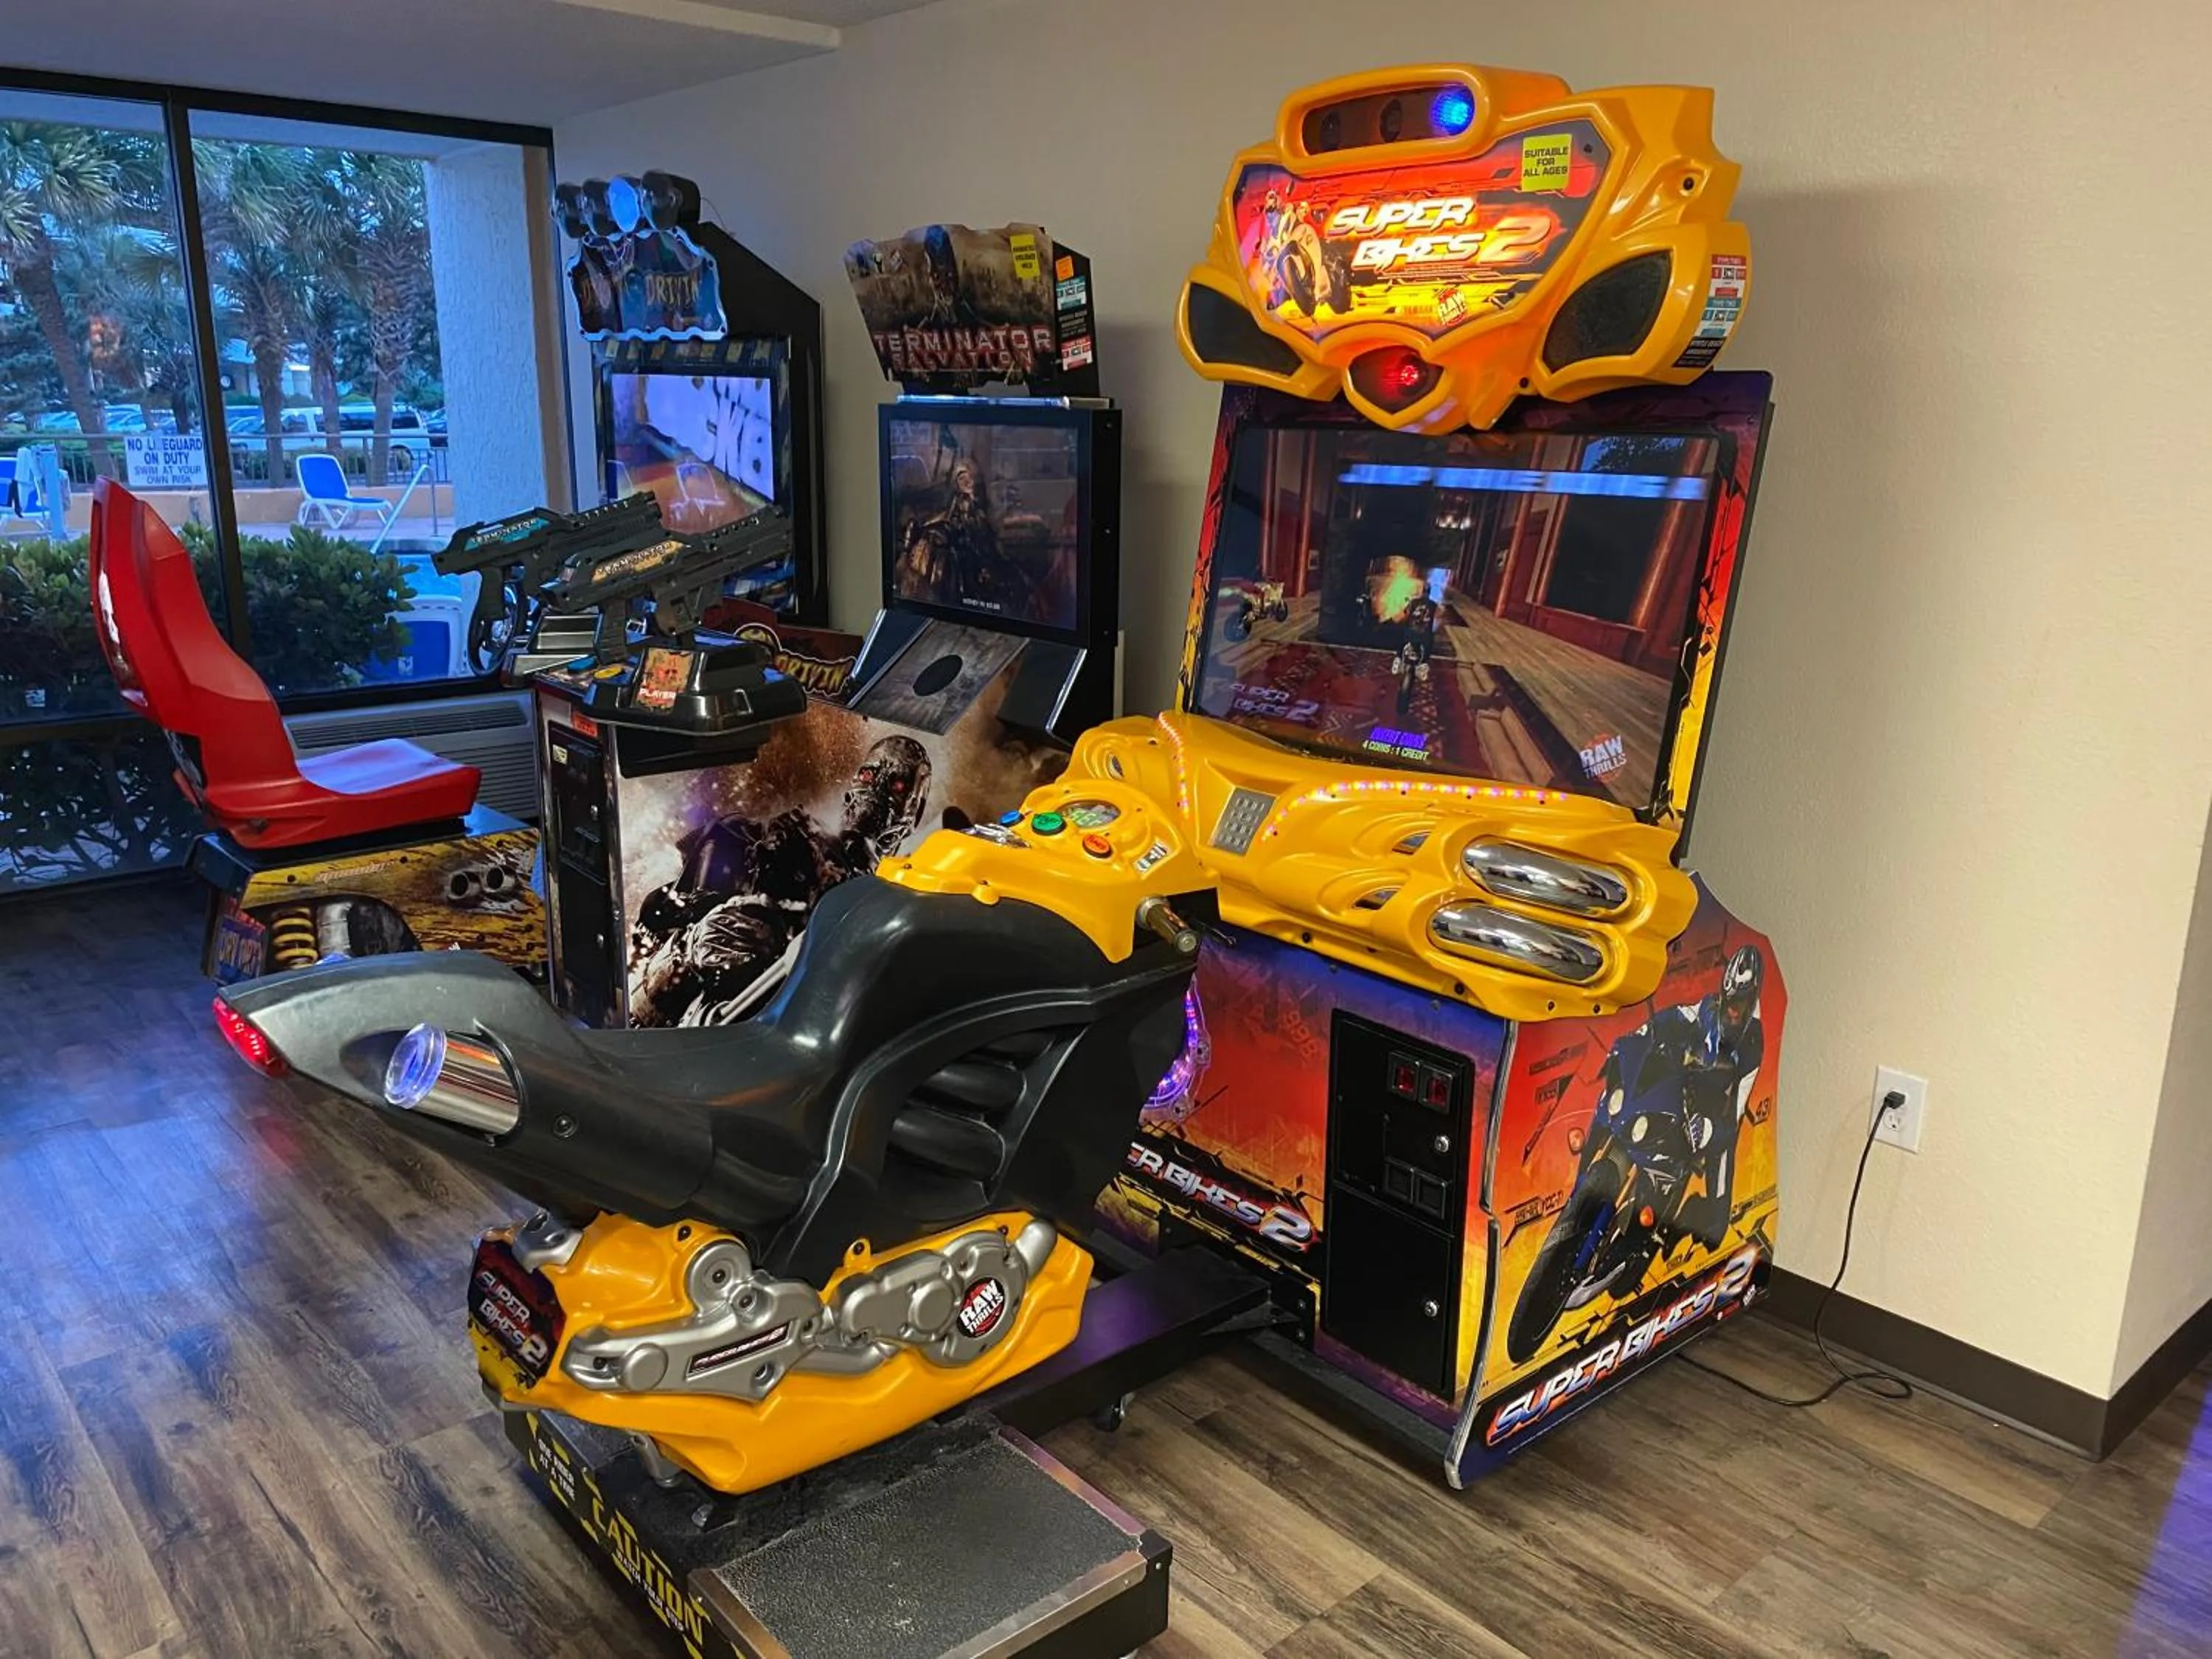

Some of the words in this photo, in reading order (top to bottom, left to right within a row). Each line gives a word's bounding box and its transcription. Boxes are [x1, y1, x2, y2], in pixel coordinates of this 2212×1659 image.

[1525, 147, 1569, 159] SUITABLE
[1537, 157, 1555, 167] FOR
[1523, 169, 1540, 177] ALL
[1543, 166, 1568, 175] AGES
[1327, 196, 1475, 237] SUPER
[1351, 232, 1487, 272] BIKES
[1476, 215, 1551, 264] 2
[1438, 291, 1465, 318] RAW
[874, 329, 1051, 352] TERMINATOR
[892, 350, 1032, 373] SALVATION
[128, 438, 143, 451] NO
[147, 438, 203, 451] LIEGUARD
[135, 466, 159, 475] SWIM
[163, 466, 173, 474] AT
[178, 466, 201, 474] YOUR
[145, 452, 159, 465] ON
[164, 452, 189, 465] DUTY
[147, 476, 169, 484] OWN
[639, 688, 677, 700] PLAYER
[1285, 700, 1320, 721] 2
[1580, 735, 1623, 768] RAW
[1583, 753, 1628, 779] THRILLS
[1164, 1161, 1266, 1225] BIKES
[1259, 1205, 1312, 1252] 2
[480, 1270, 530, 1324] SUPER
[959, 1279, 999, 1327] RAW
[967, 1293, 1004, 1333] THRILLS
[480, 1298, 526, 1346] BIKES
[518, 1334, 549, 1368] 2
[1492, 1339, 1622, 1440] SUPER
[1621, 1282, 1718, 1358] BIKES
[1717, 1246, 1757, 1299] 2
[592, 1498, 703, 1646] CAUTION
